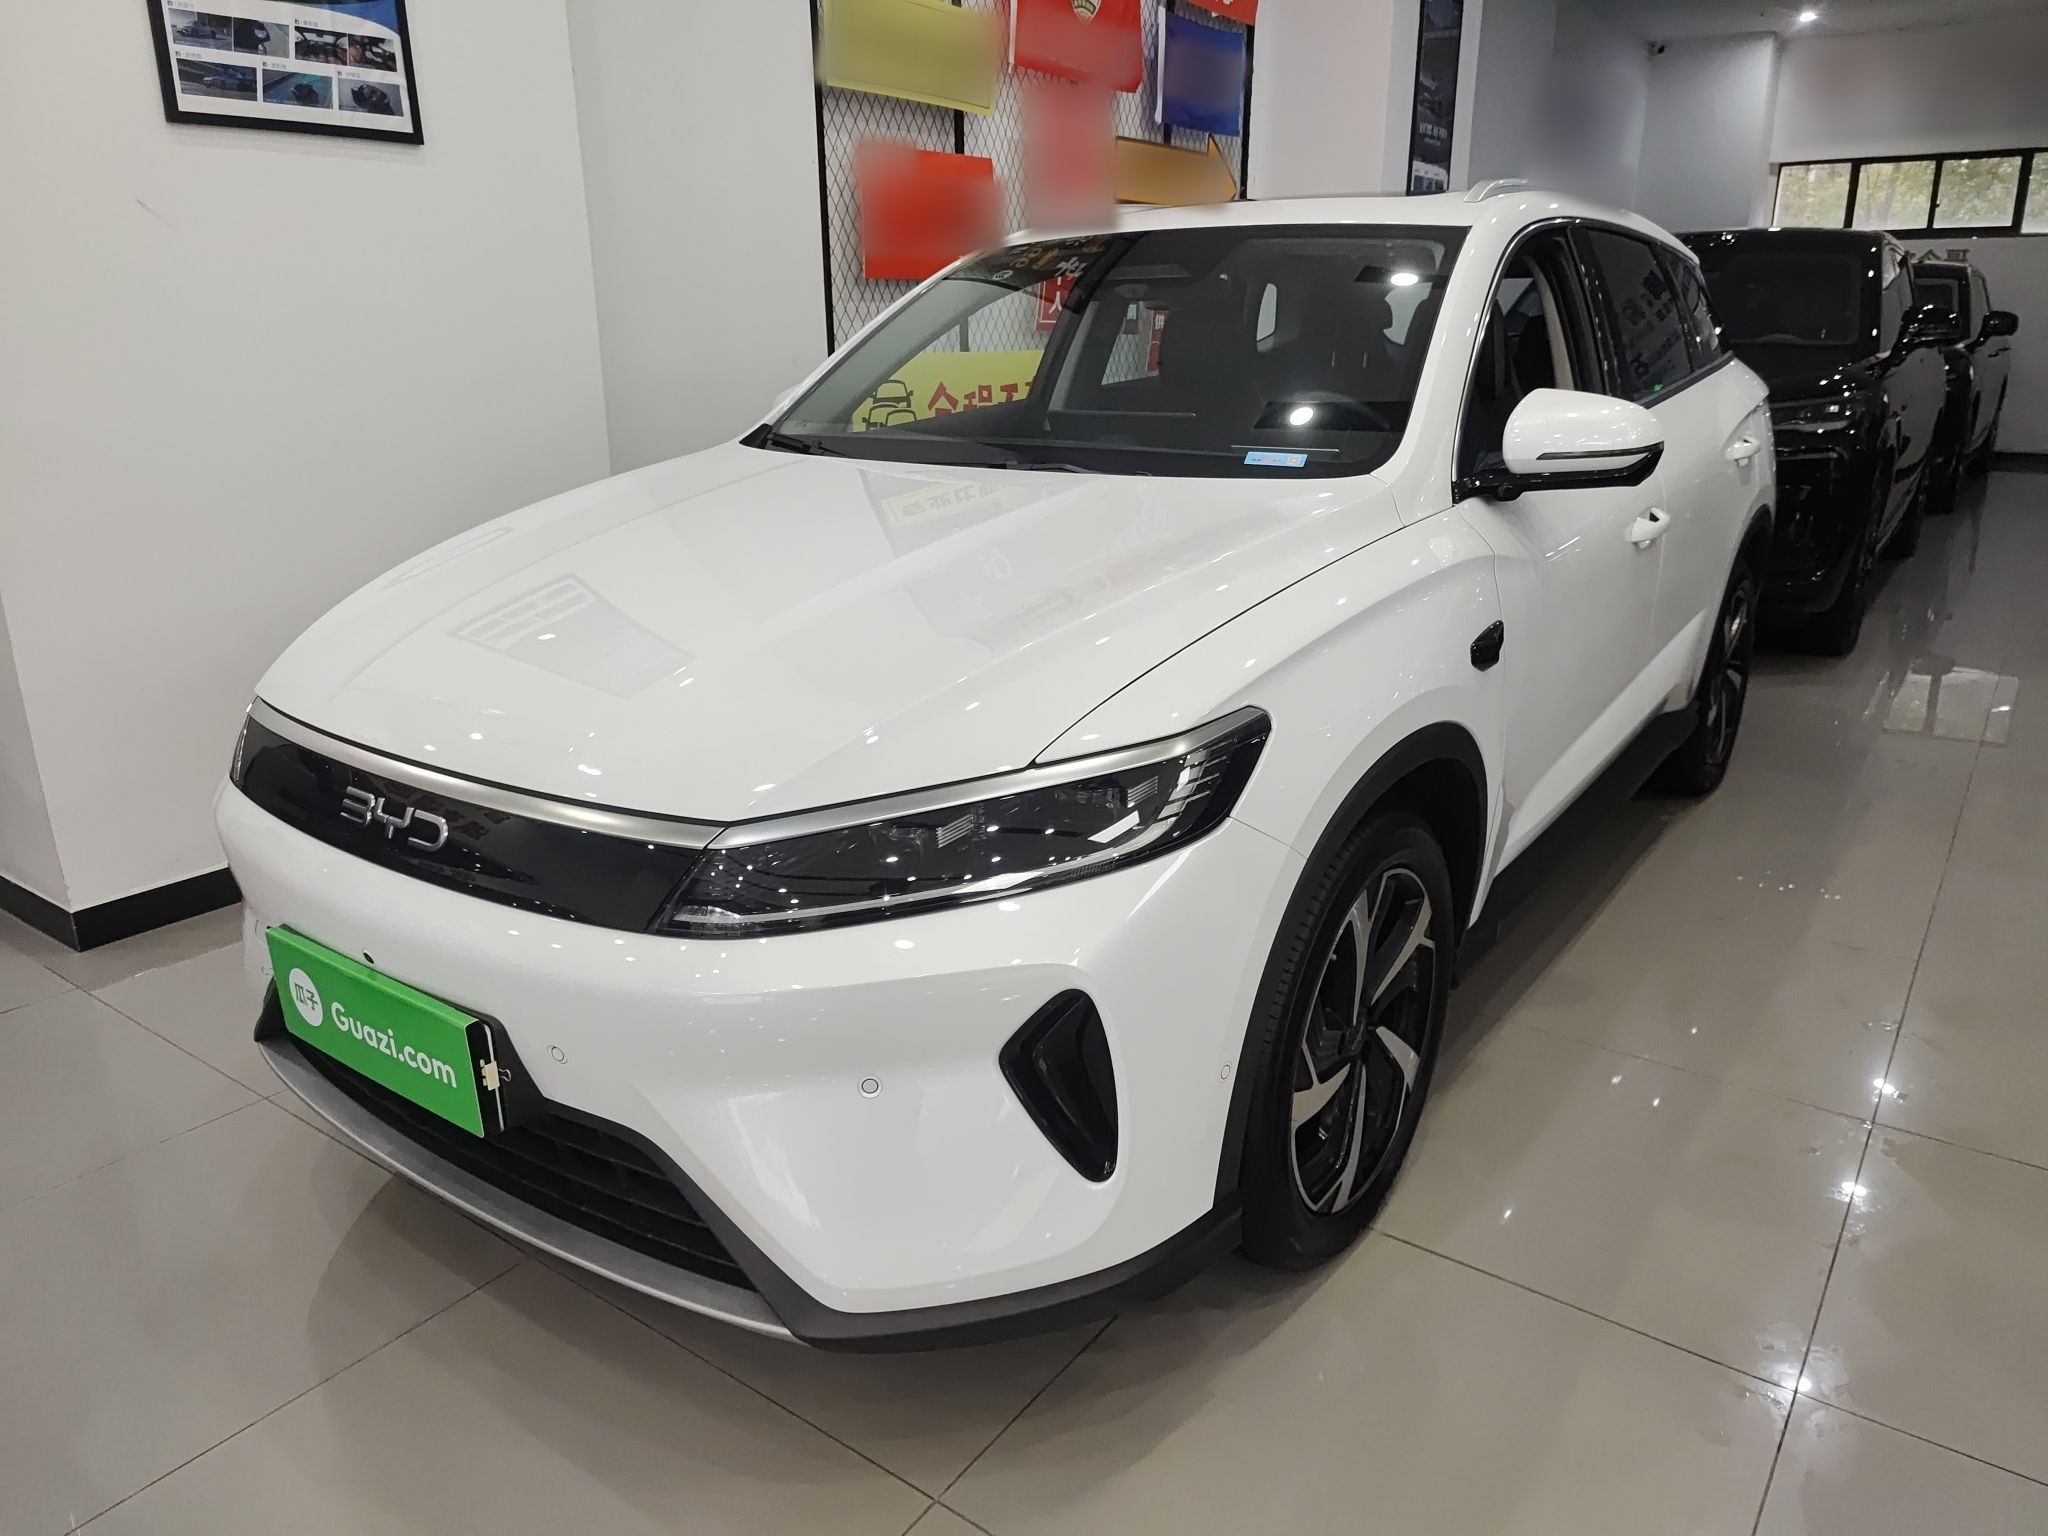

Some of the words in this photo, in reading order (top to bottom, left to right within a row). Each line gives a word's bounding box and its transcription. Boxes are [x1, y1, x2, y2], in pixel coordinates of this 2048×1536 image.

[340, 786, 449, 853] BYD
[294, 981, 319, 1012] 瓜子
[331, 1001, 457, 1089] Guazi.com
